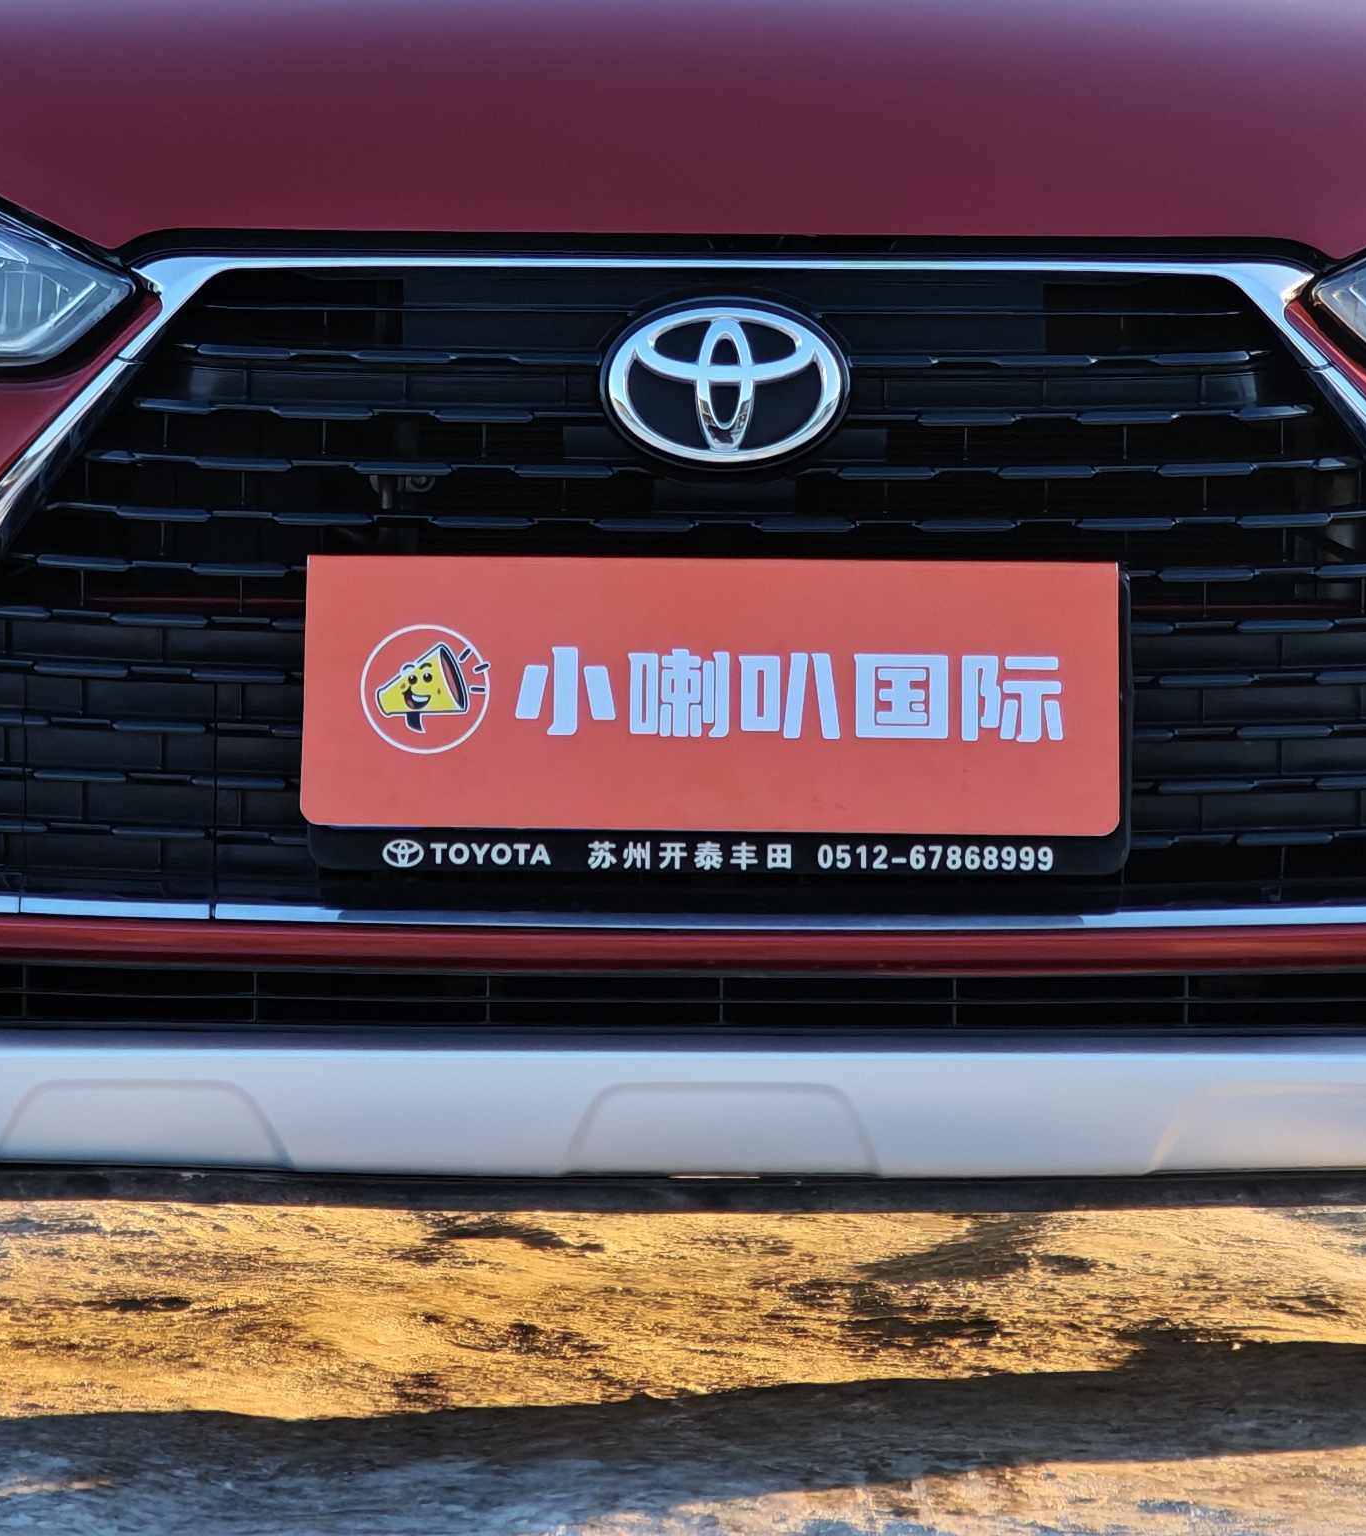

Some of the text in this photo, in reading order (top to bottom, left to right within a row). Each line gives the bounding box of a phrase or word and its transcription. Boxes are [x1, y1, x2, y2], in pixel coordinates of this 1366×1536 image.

[514, 646, 1064, 743] 小喇叭国际
[429, 840, 1054, 872] TOYOTA 苏州开泰丰田 0512-67868999
